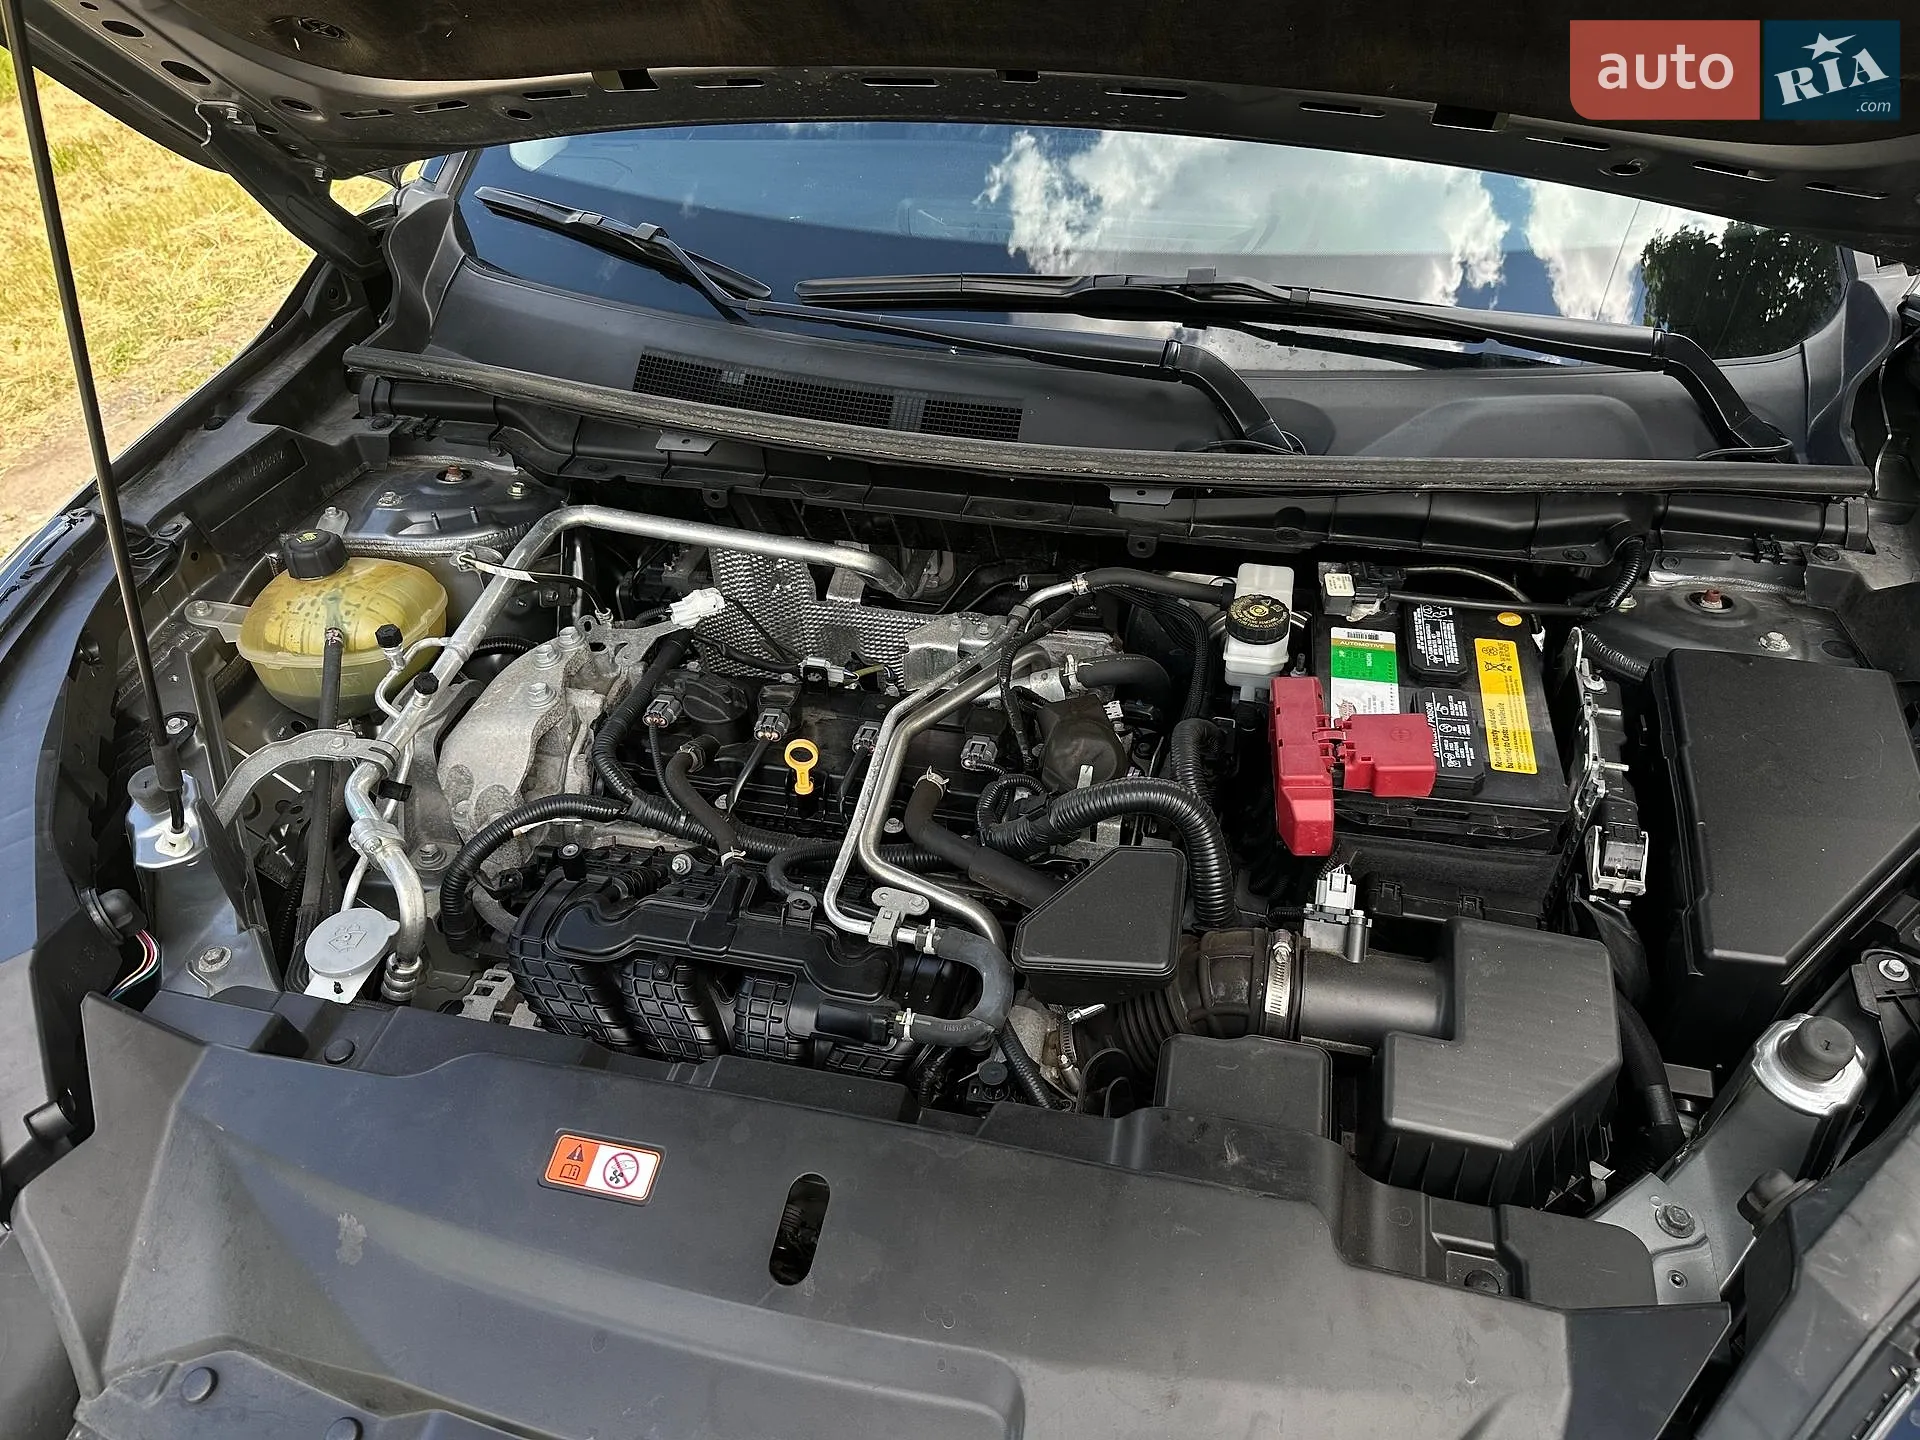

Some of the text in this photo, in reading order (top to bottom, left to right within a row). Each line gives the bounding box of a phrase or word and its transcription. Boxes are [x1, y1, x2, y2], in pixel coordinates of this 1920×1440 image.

[1339, 640, 1385, 649] AUTOMOTIVE
[1425, 702, 1435, 722] POISON
[1497, 702, 1507, 726] Wholesale
[1487, 708, 1502, 768] Return warranty and used
[1501, 726, 1510, 742] Costco
[1503, 748, 1514, 769] batteries
